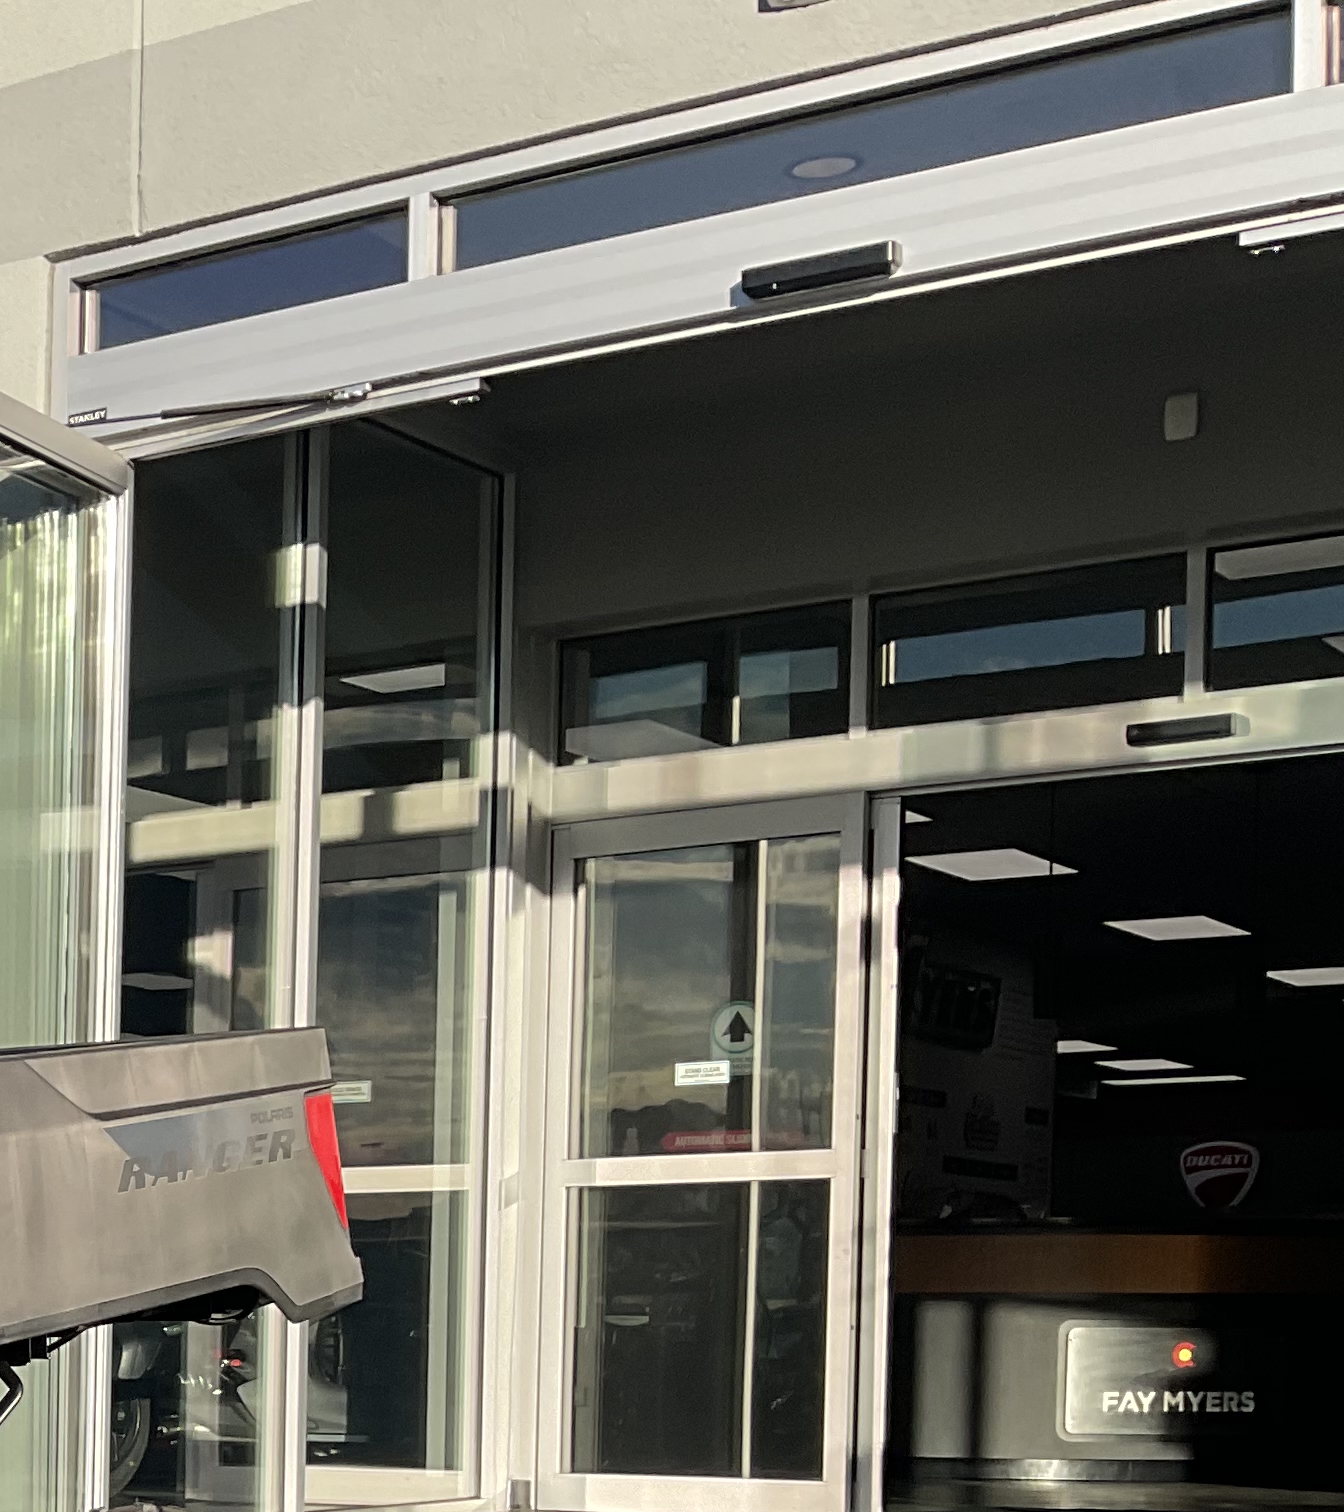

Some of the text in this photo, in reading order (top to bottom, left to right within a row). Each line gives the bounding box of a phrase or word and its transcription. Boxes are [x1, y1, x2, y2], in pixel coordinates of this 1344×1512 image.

[69, 409, 106, 424] STANLEY
[250, 1106, 294, 1125] POLARIS
[1185, 1153, 1249, 1167] DUCATI
[1102, 1390, 1255, 1413] FAY MYERS
